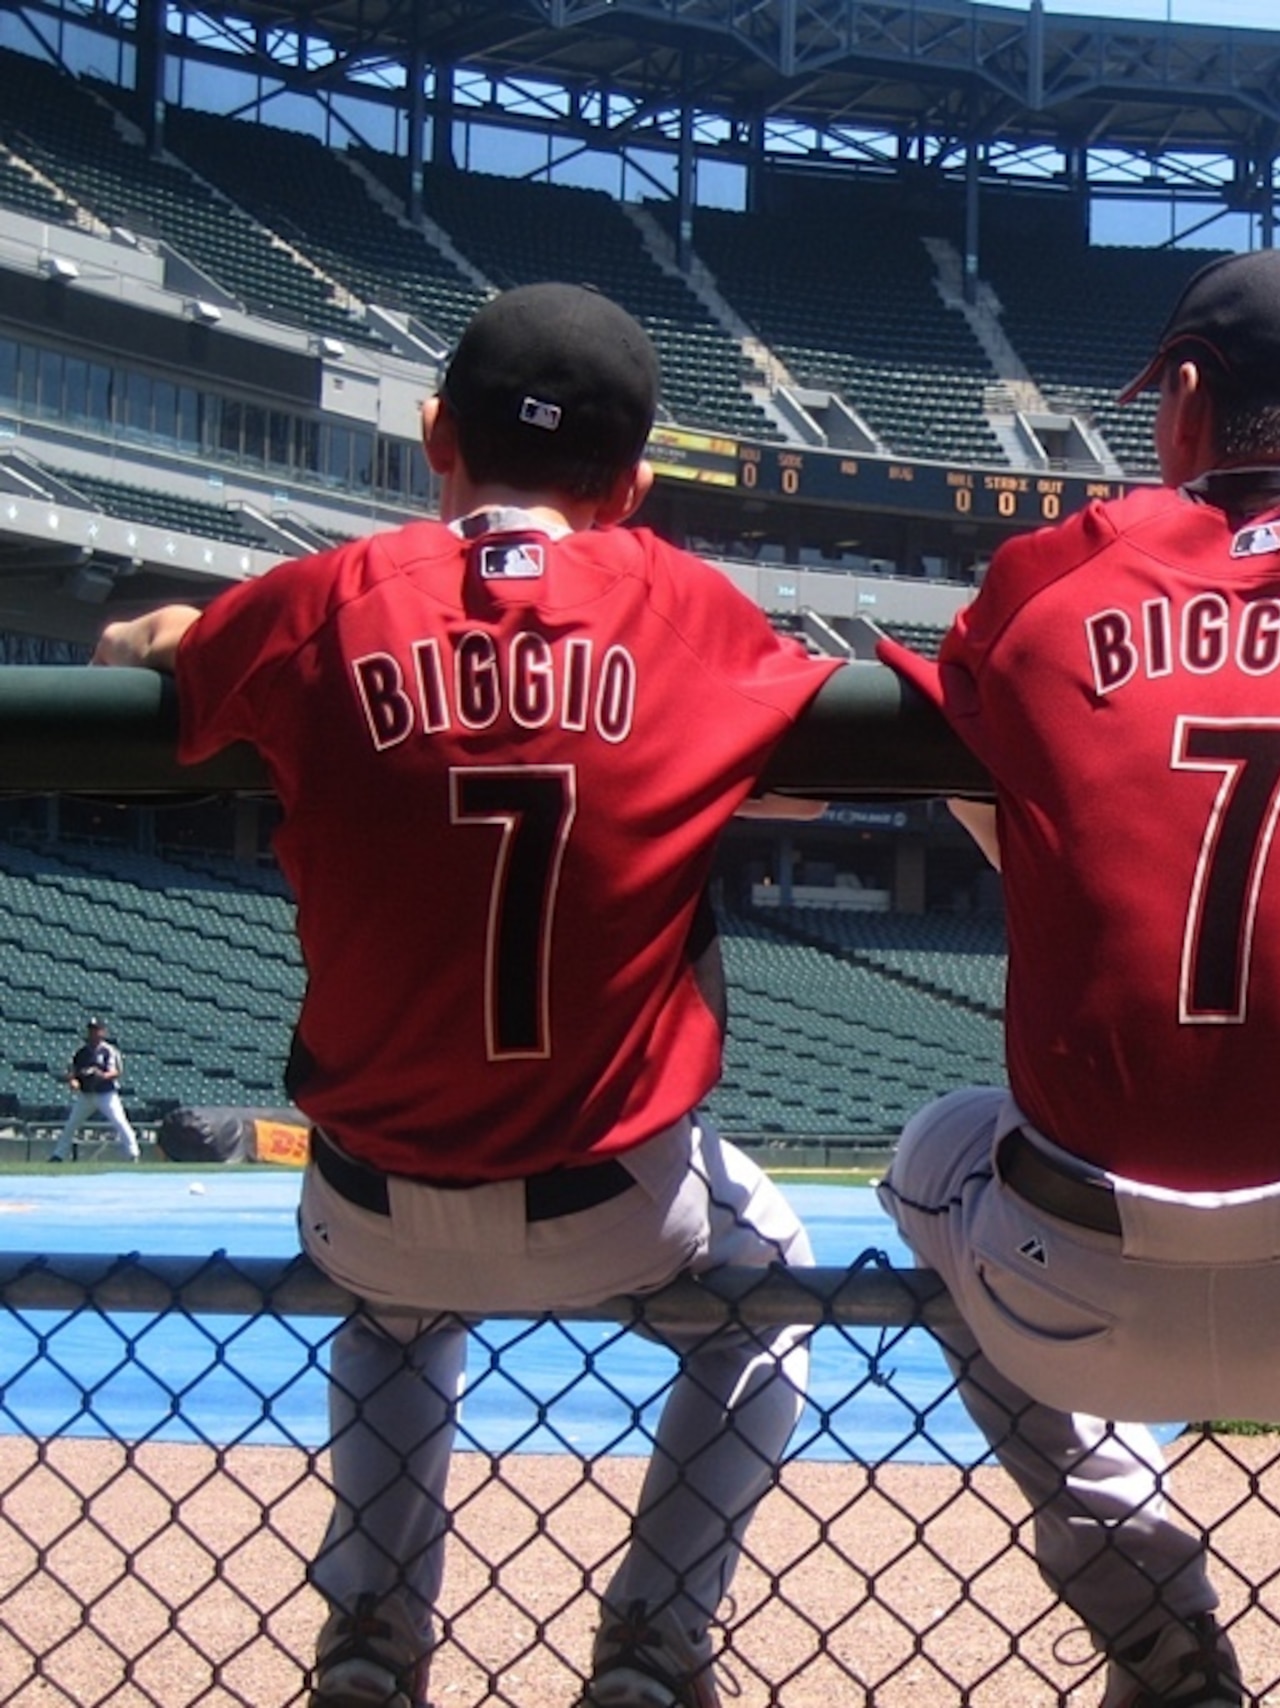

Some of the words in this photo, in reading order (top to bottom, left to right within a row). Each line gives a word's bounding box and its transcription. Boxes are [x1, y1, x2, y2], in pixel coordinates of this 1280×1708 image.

[998, 491, 1016, 516] 0
[1042, 494, 1060, 519] 0
[352, 629, 636, 751] BIGGIO
[448, 763, 577, 1062] 7
